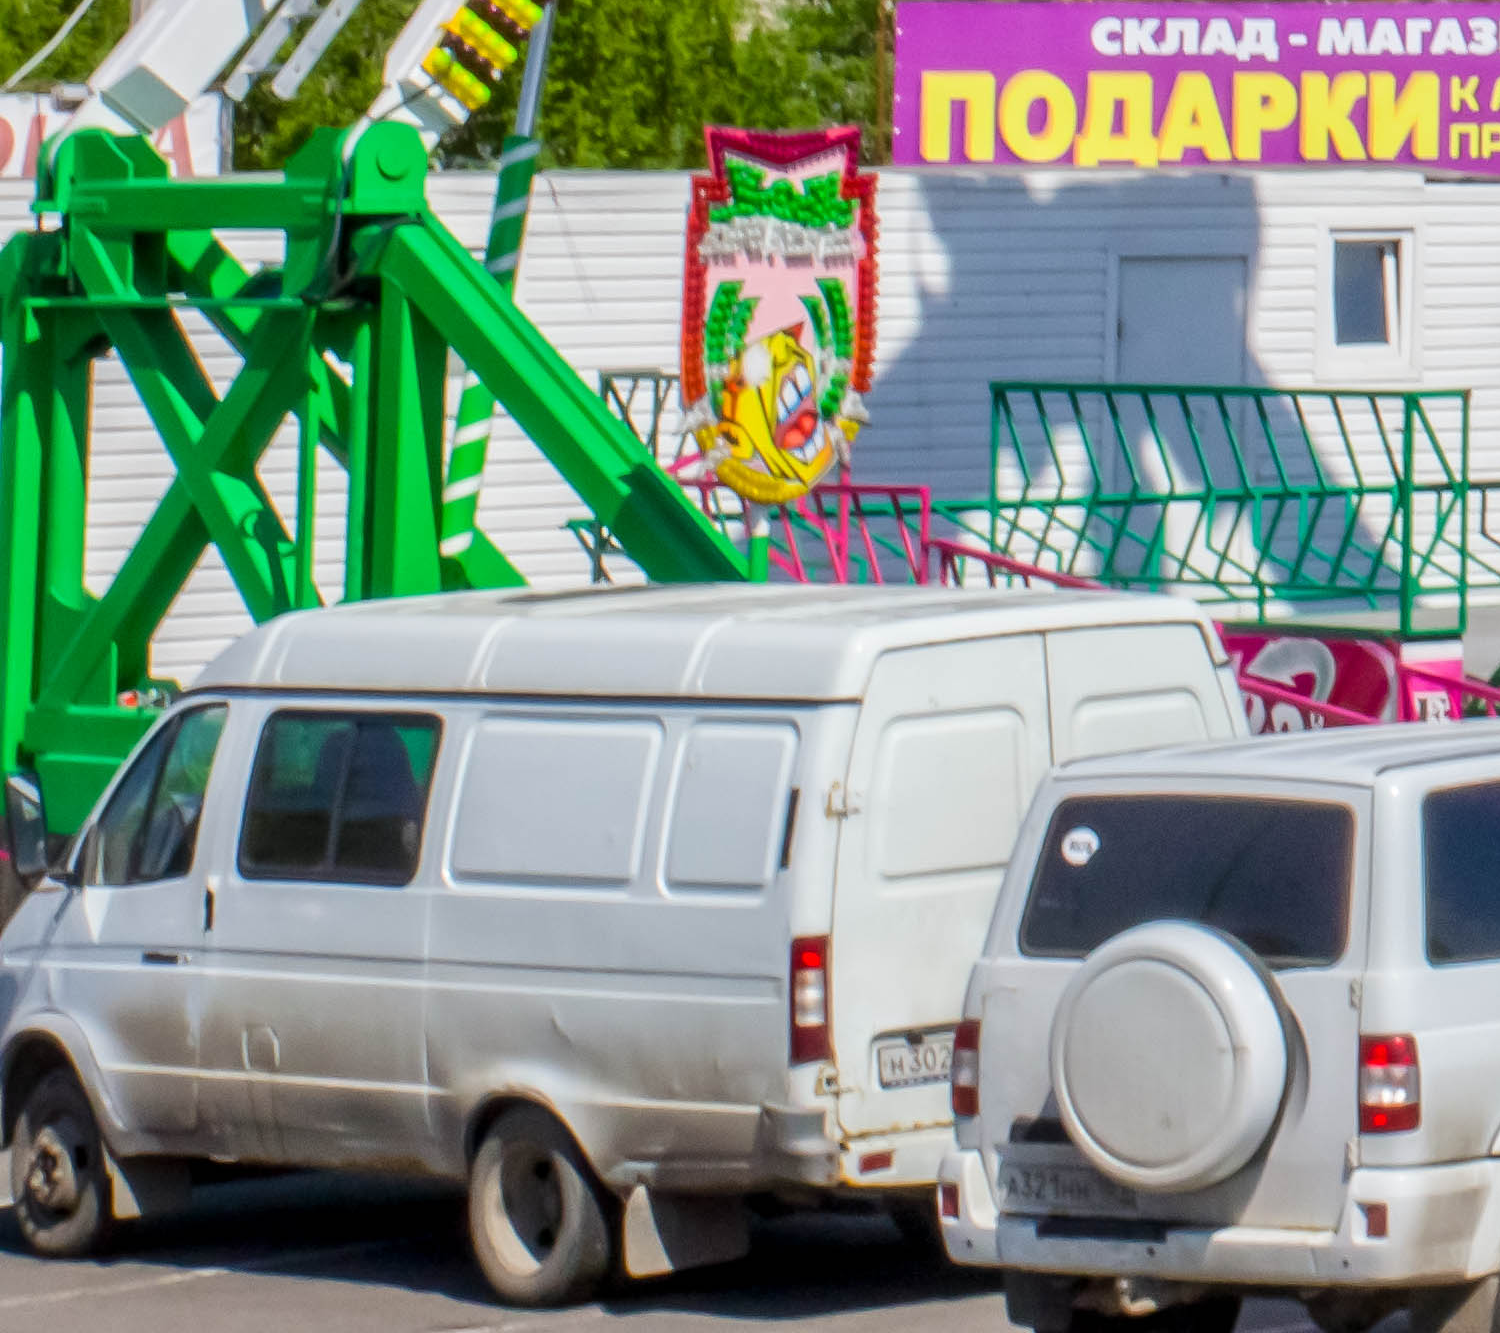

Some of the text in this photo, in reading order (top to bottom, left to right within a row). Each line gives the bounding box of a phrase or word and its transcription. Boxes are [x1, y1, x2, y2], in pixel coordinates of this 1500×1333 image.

[1091, 16, 1279, 62] СКЛАД
[1451, 74, 1480, 111] К
[919, 69, 1440, 169] ПОДАРКИ
